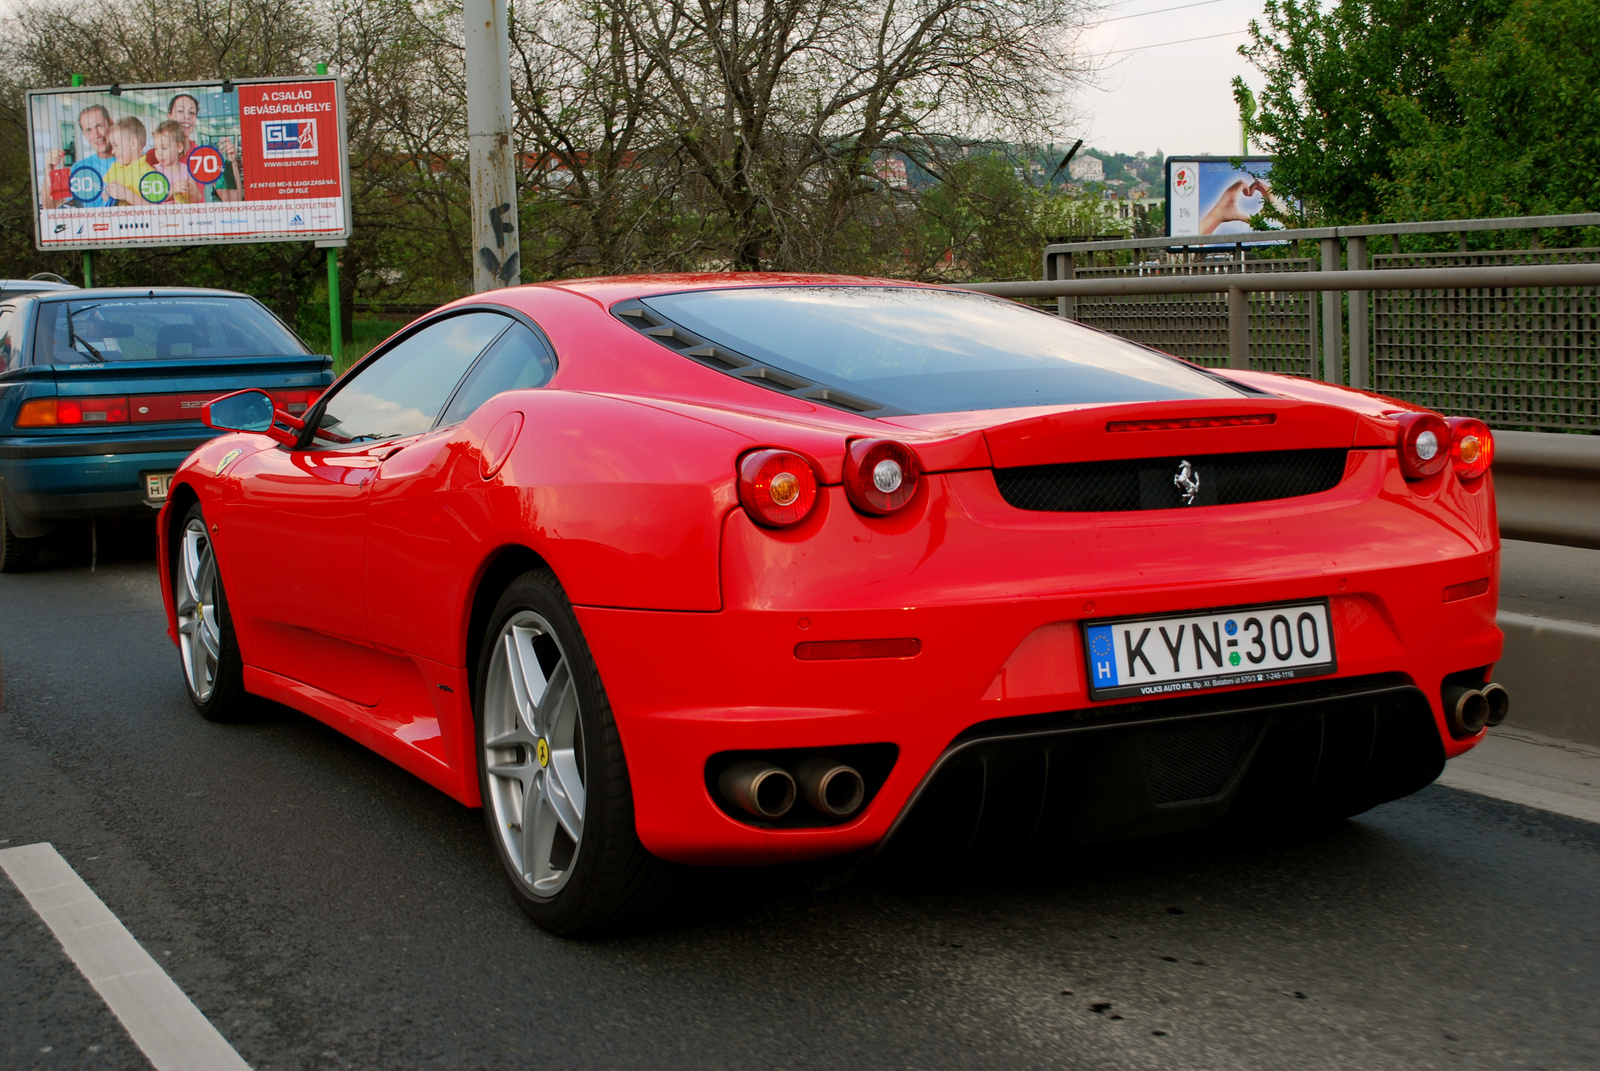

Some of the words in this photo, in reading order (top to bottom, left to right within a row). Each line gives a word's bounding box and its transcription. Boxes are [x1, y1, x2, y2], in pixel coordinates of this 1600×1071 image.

[262, 93, 269, 101] A
[271, 89, 312, 100] CSALÁD
[244, 102, 332, 115] BEVÁSÁRLÓHELYE
[266, 125, 298, 142] GL
[151, 486, 160, 495] H
[1097, 661, 1111, 679] H
[1140, 685, 1162, 695] VOLKS
[1163, 683, 1181, 693] AUTO
[1193, 681, 1202, 690] Bp.
[1213, 677, 1234, 687] Balatoni
